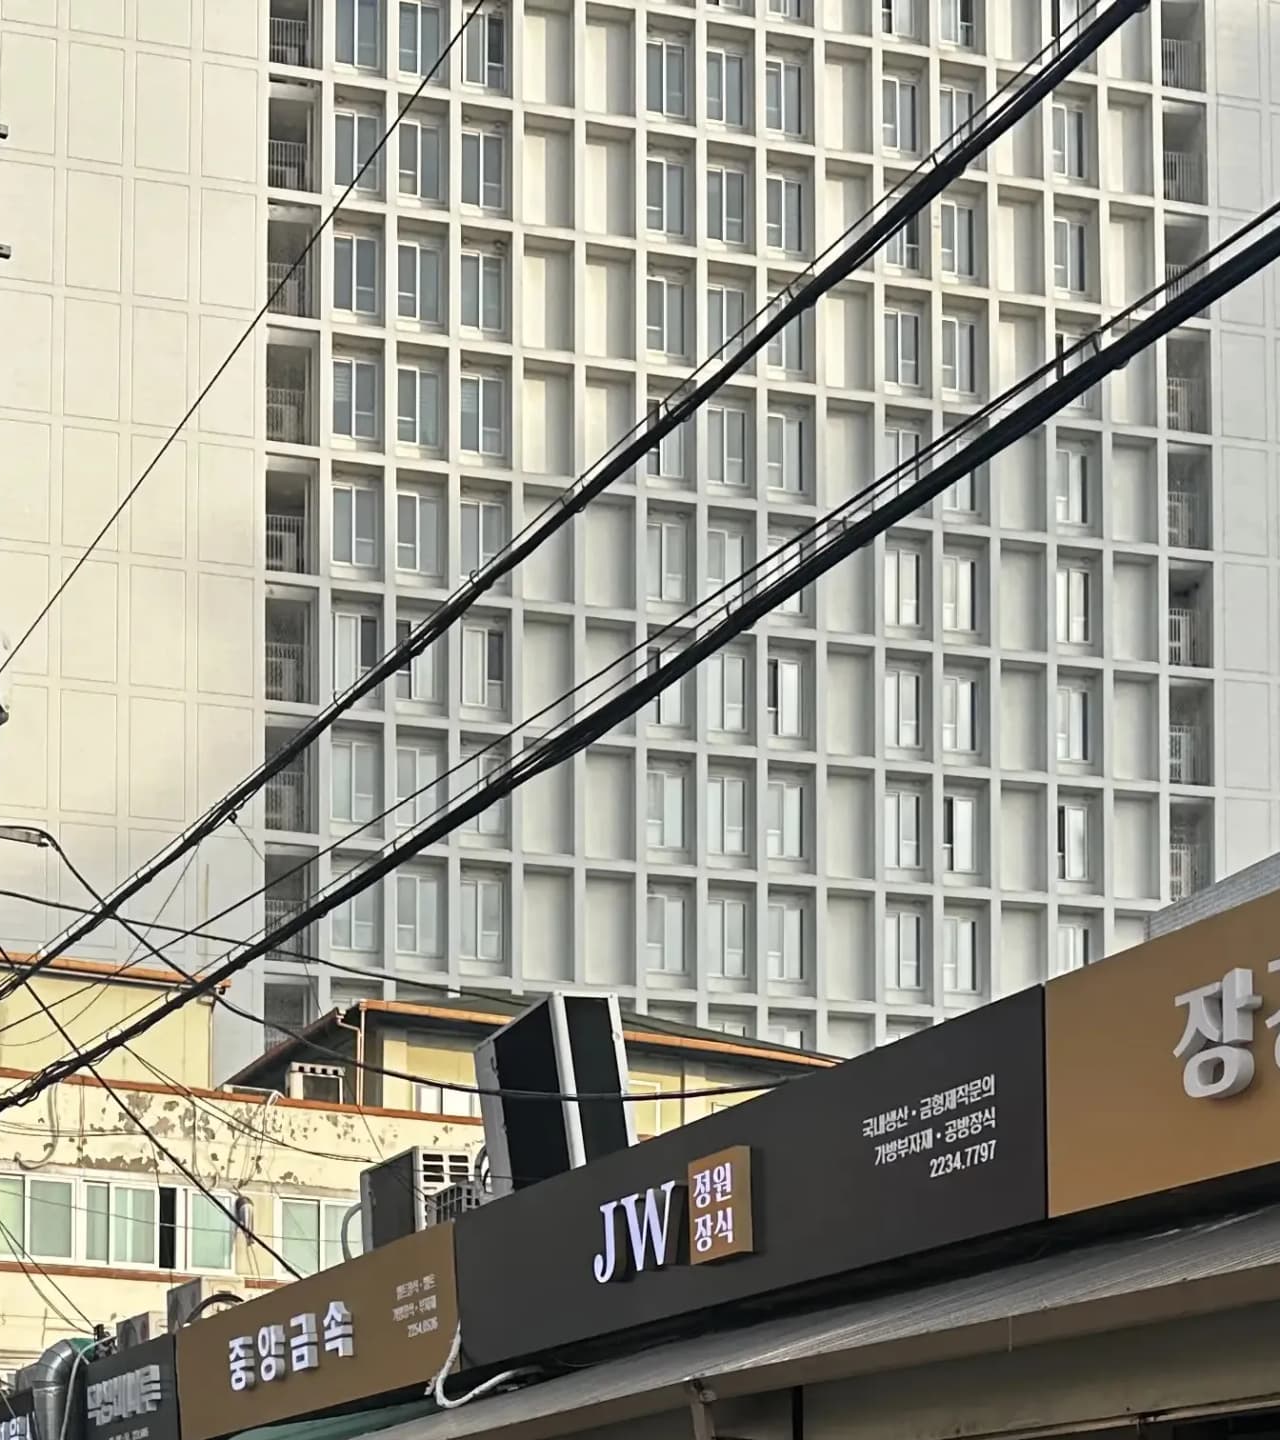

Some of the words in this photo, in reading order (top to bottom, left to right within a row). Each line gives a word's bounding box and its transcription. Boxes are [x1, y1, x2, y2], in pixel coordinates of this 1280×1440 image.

[862, 1104, 909, 1138] 국내생산
[920, 1073, 996, 1121] 금형제작문의
[874, 1127, 934, 1167] 가방부자재
[944, 1106, 997, 1143] 공방장식
[929, 1139, 998, 1179] 2234.7797
[692, 1162, 732, 1209] 정원
[593, 1180, 676, 1284] JW
[694, 1206, 734, 1252] 장식
[228, 1300, 355, 1391] 중앙금속
